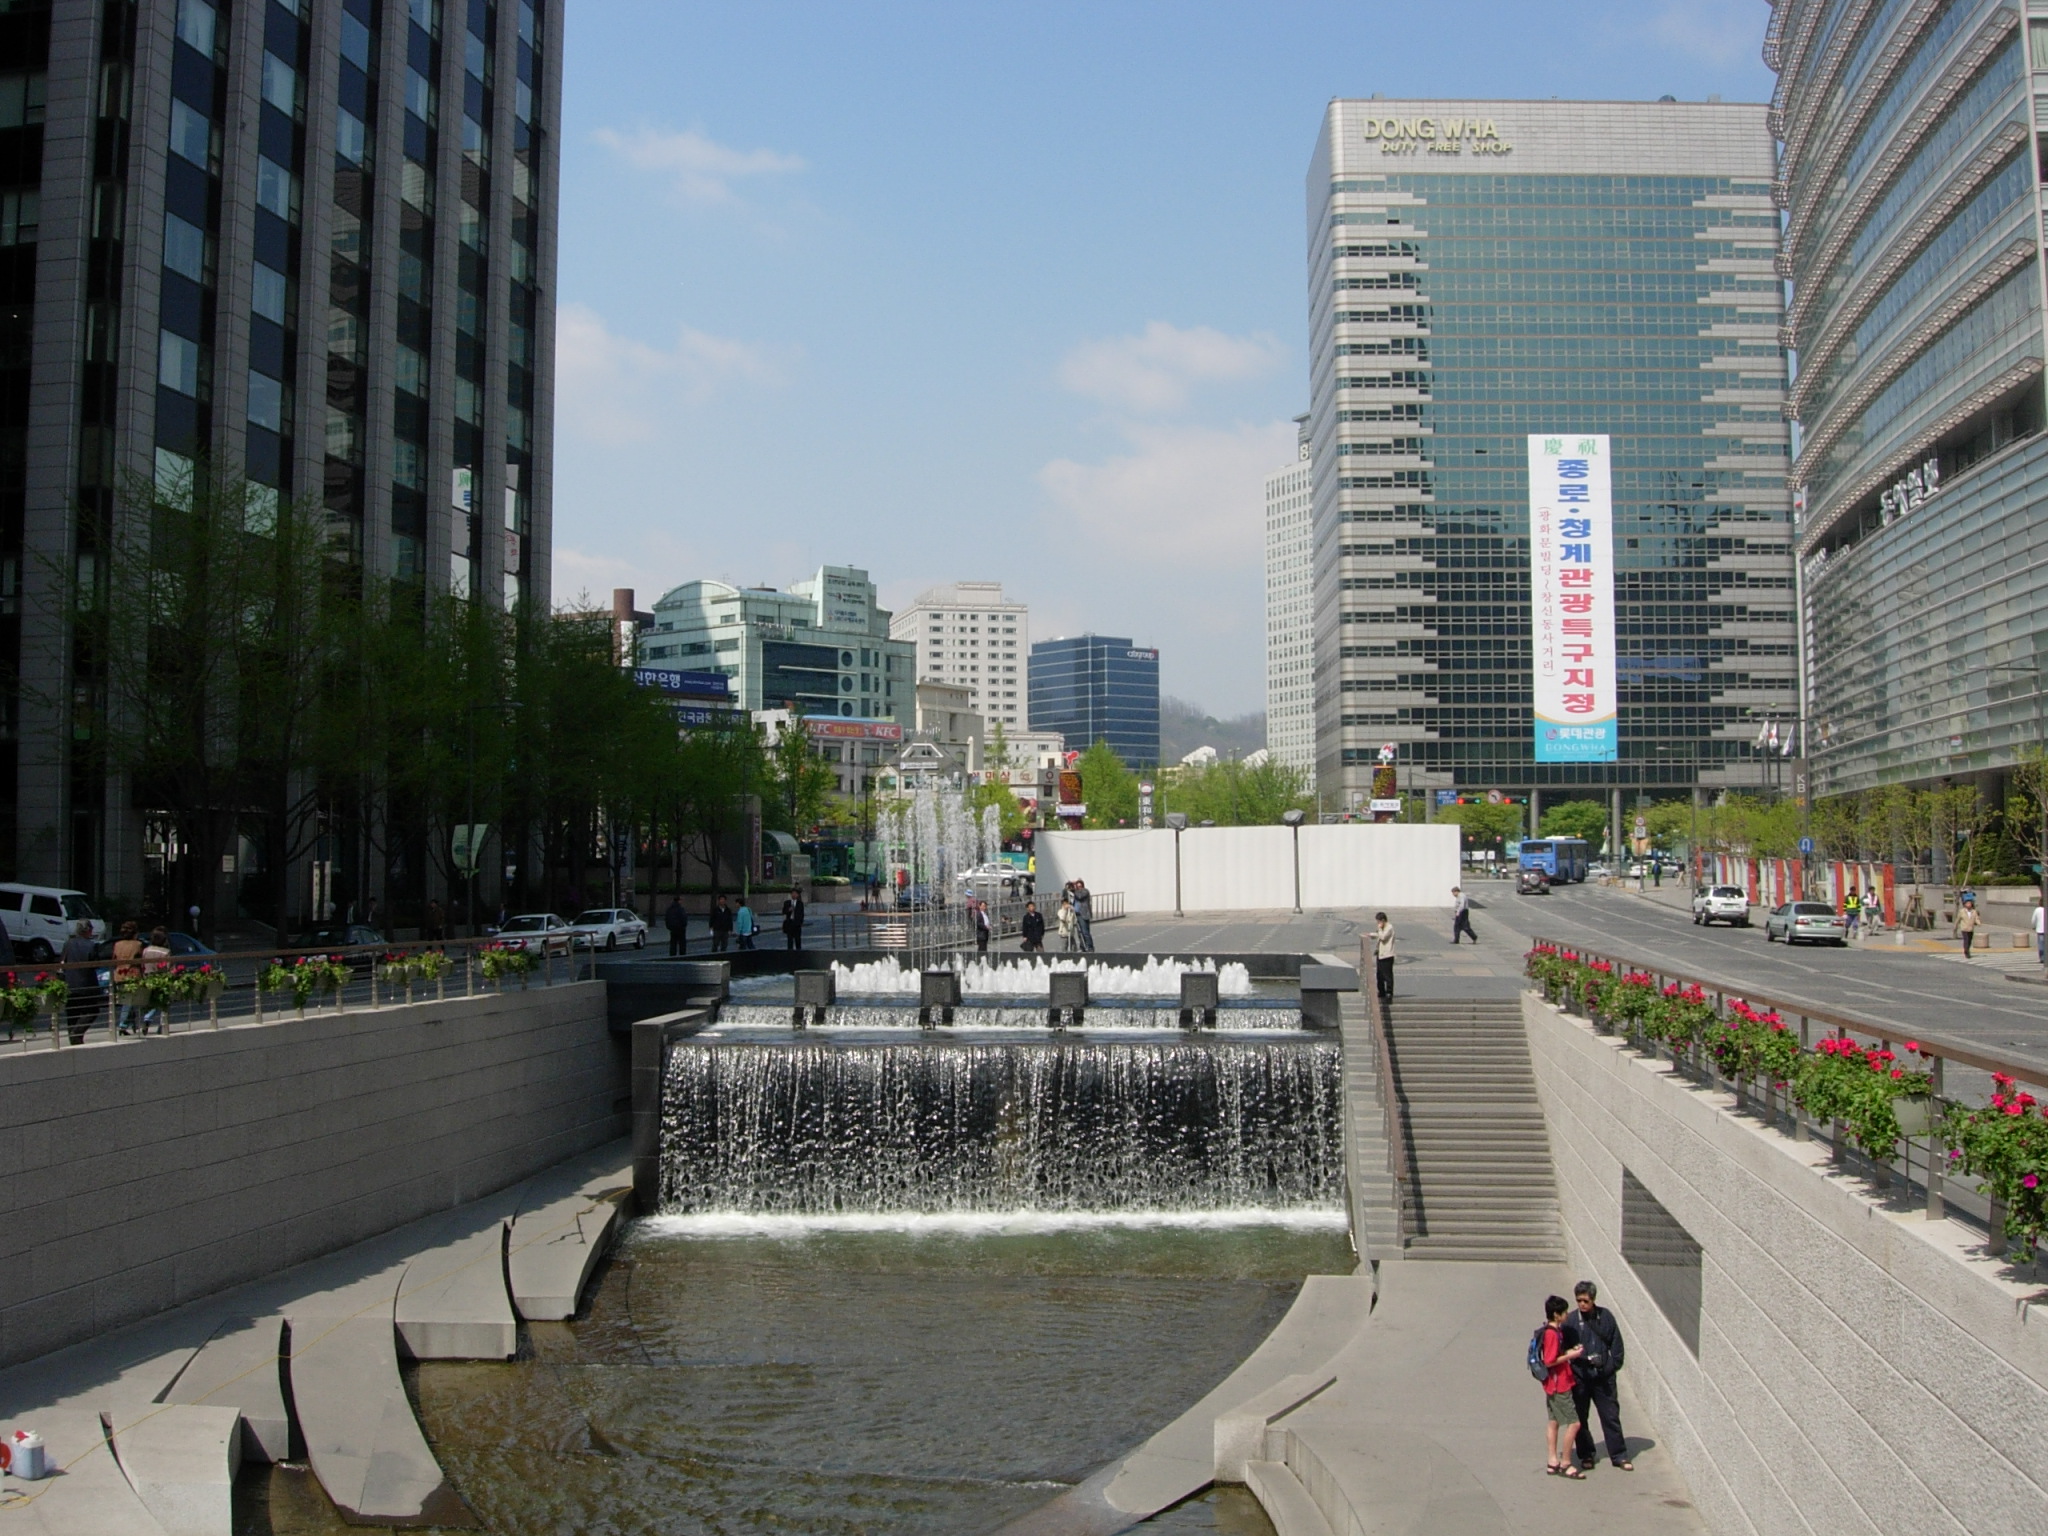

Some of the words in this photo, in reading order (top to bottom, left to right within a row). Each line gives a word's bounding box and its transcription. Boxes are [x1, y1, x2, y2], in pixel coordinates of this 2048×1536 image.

[1364, 118, 1435, 139] DONG
[1441, 118, 1499, 139] WHA
[1381, 142, 1417, 152] DUTY
[1427, 142, 1461, 152] FREE
[1472, 142, 1513, 152] SHOP
[875, 725, 897, 737] KFC
[1559, 728, 1606, 740] 롯데관광
[1796, 773, 1806, 793] KB
[765, 861, 772, 869] P
